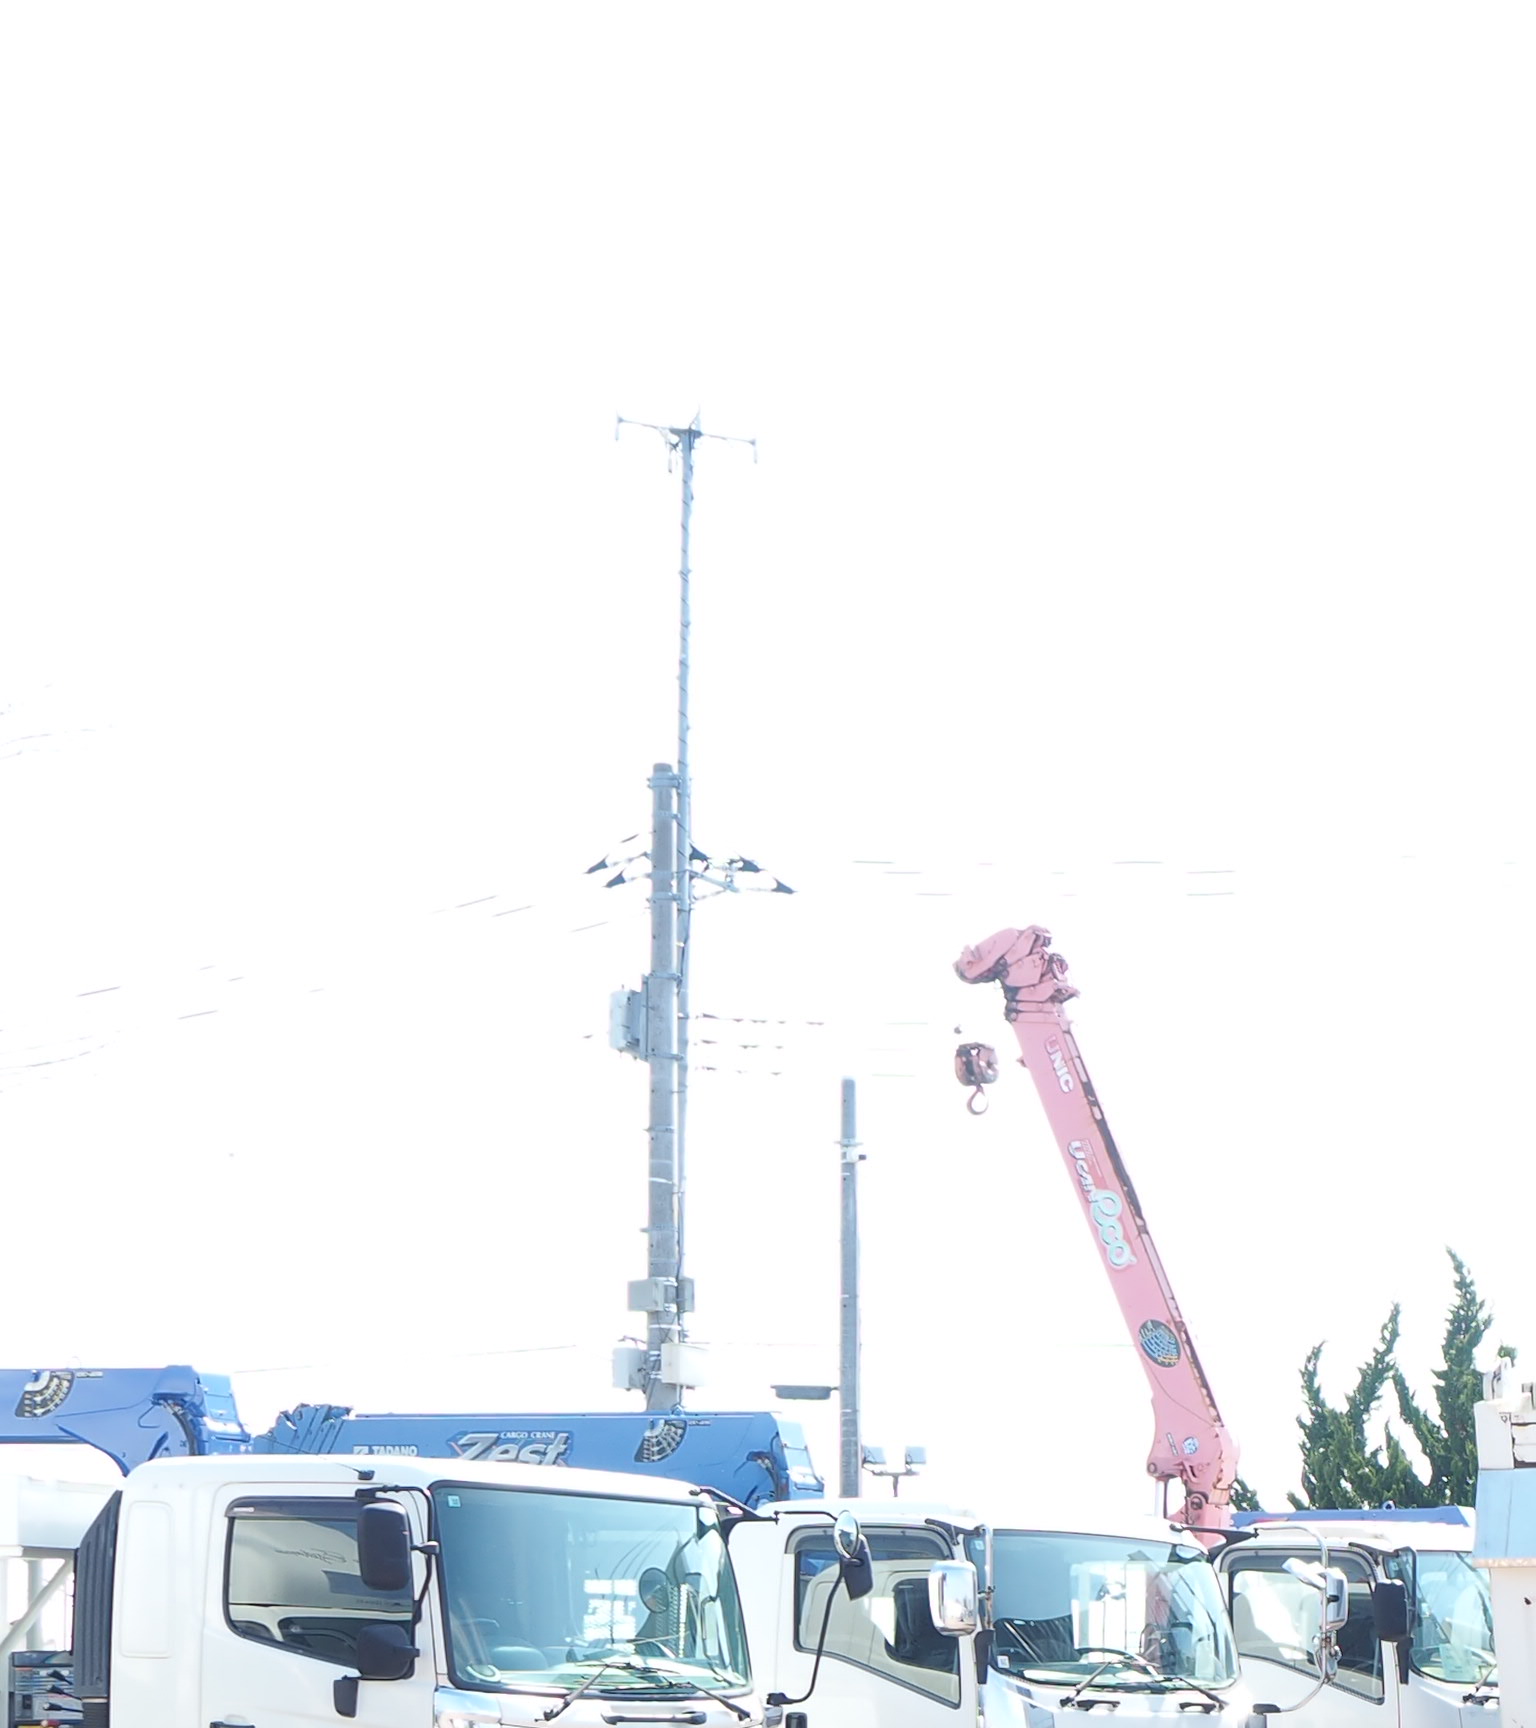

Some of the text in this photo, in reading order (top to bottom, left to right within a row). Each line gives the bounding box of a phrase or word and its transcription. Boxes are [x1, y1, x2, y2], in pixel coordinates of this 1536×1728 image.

[1045, 1034, 1075, 1094] UNIC
[500, 1432, 556, 1440] CARGO CRANE
[372, 1445, 418, 1456] TADANO
[457, 1432, 568, 1466] Zest
